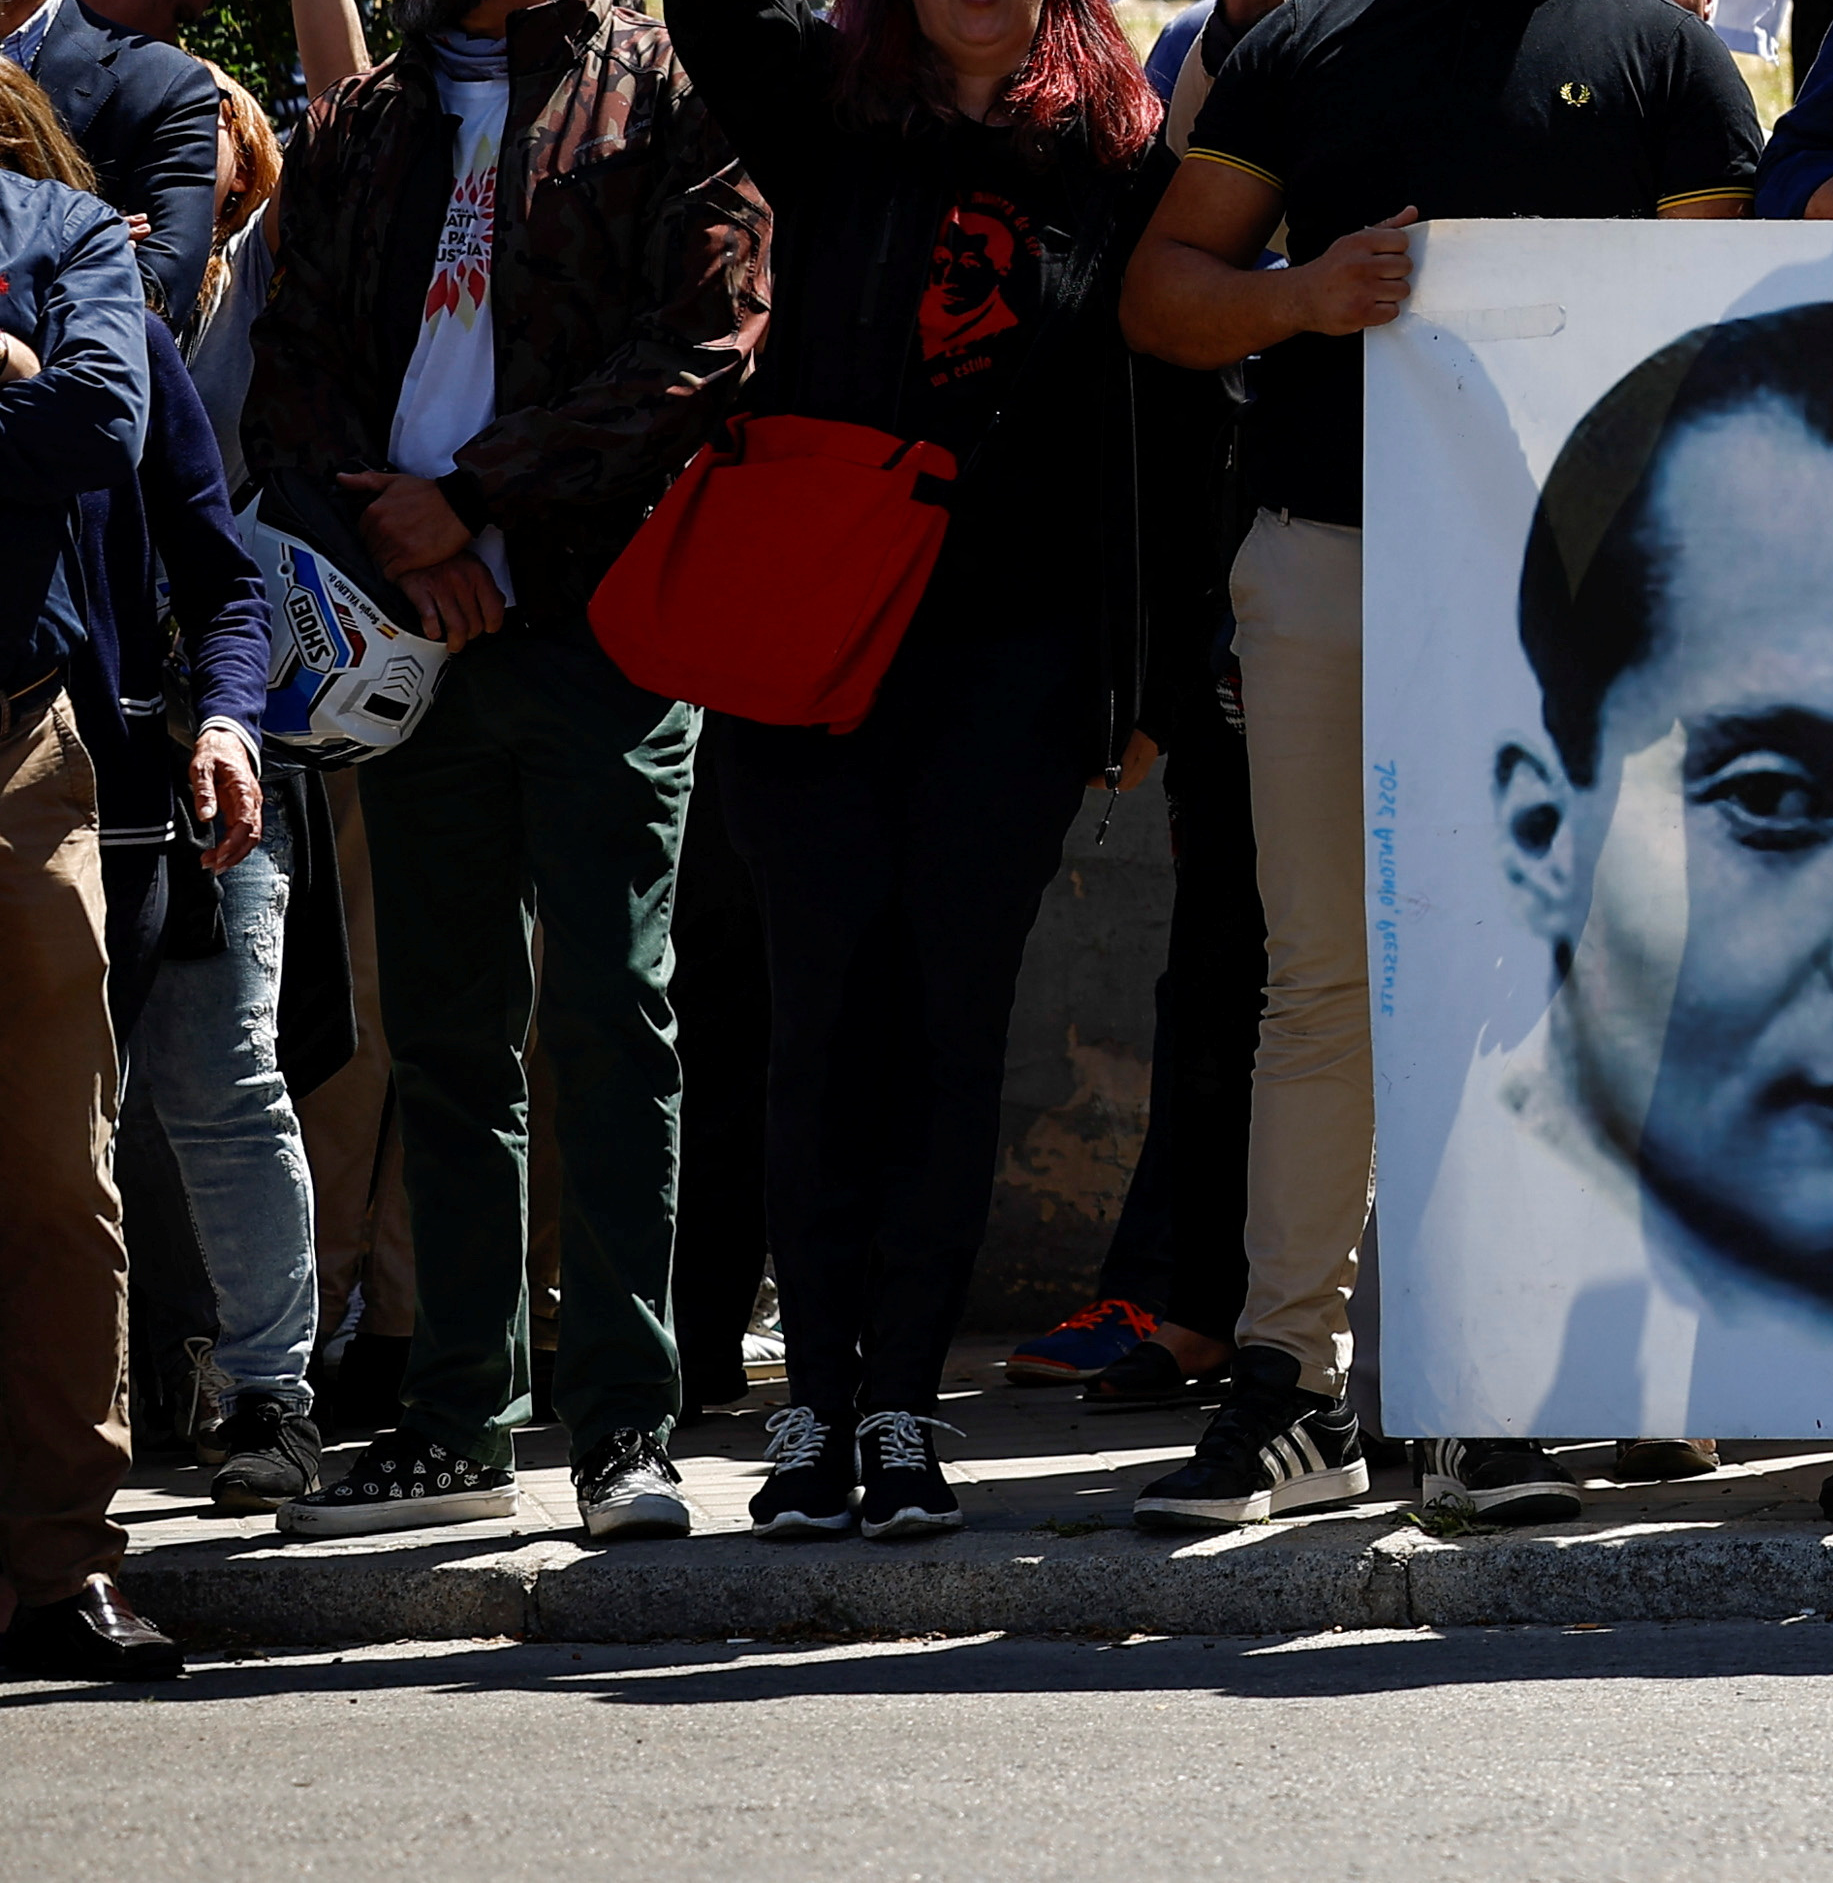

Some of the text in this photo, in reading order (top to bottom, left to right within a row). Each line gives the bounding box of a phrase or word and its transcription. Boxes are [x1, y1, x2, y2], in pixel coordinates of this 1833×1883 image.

[952, 355, 993, 379] estilo
[334, 580, 360, 608] VALERO
[359, 603, 380, 626] Sergio
[289, 594, 331, 664] SHOEI
